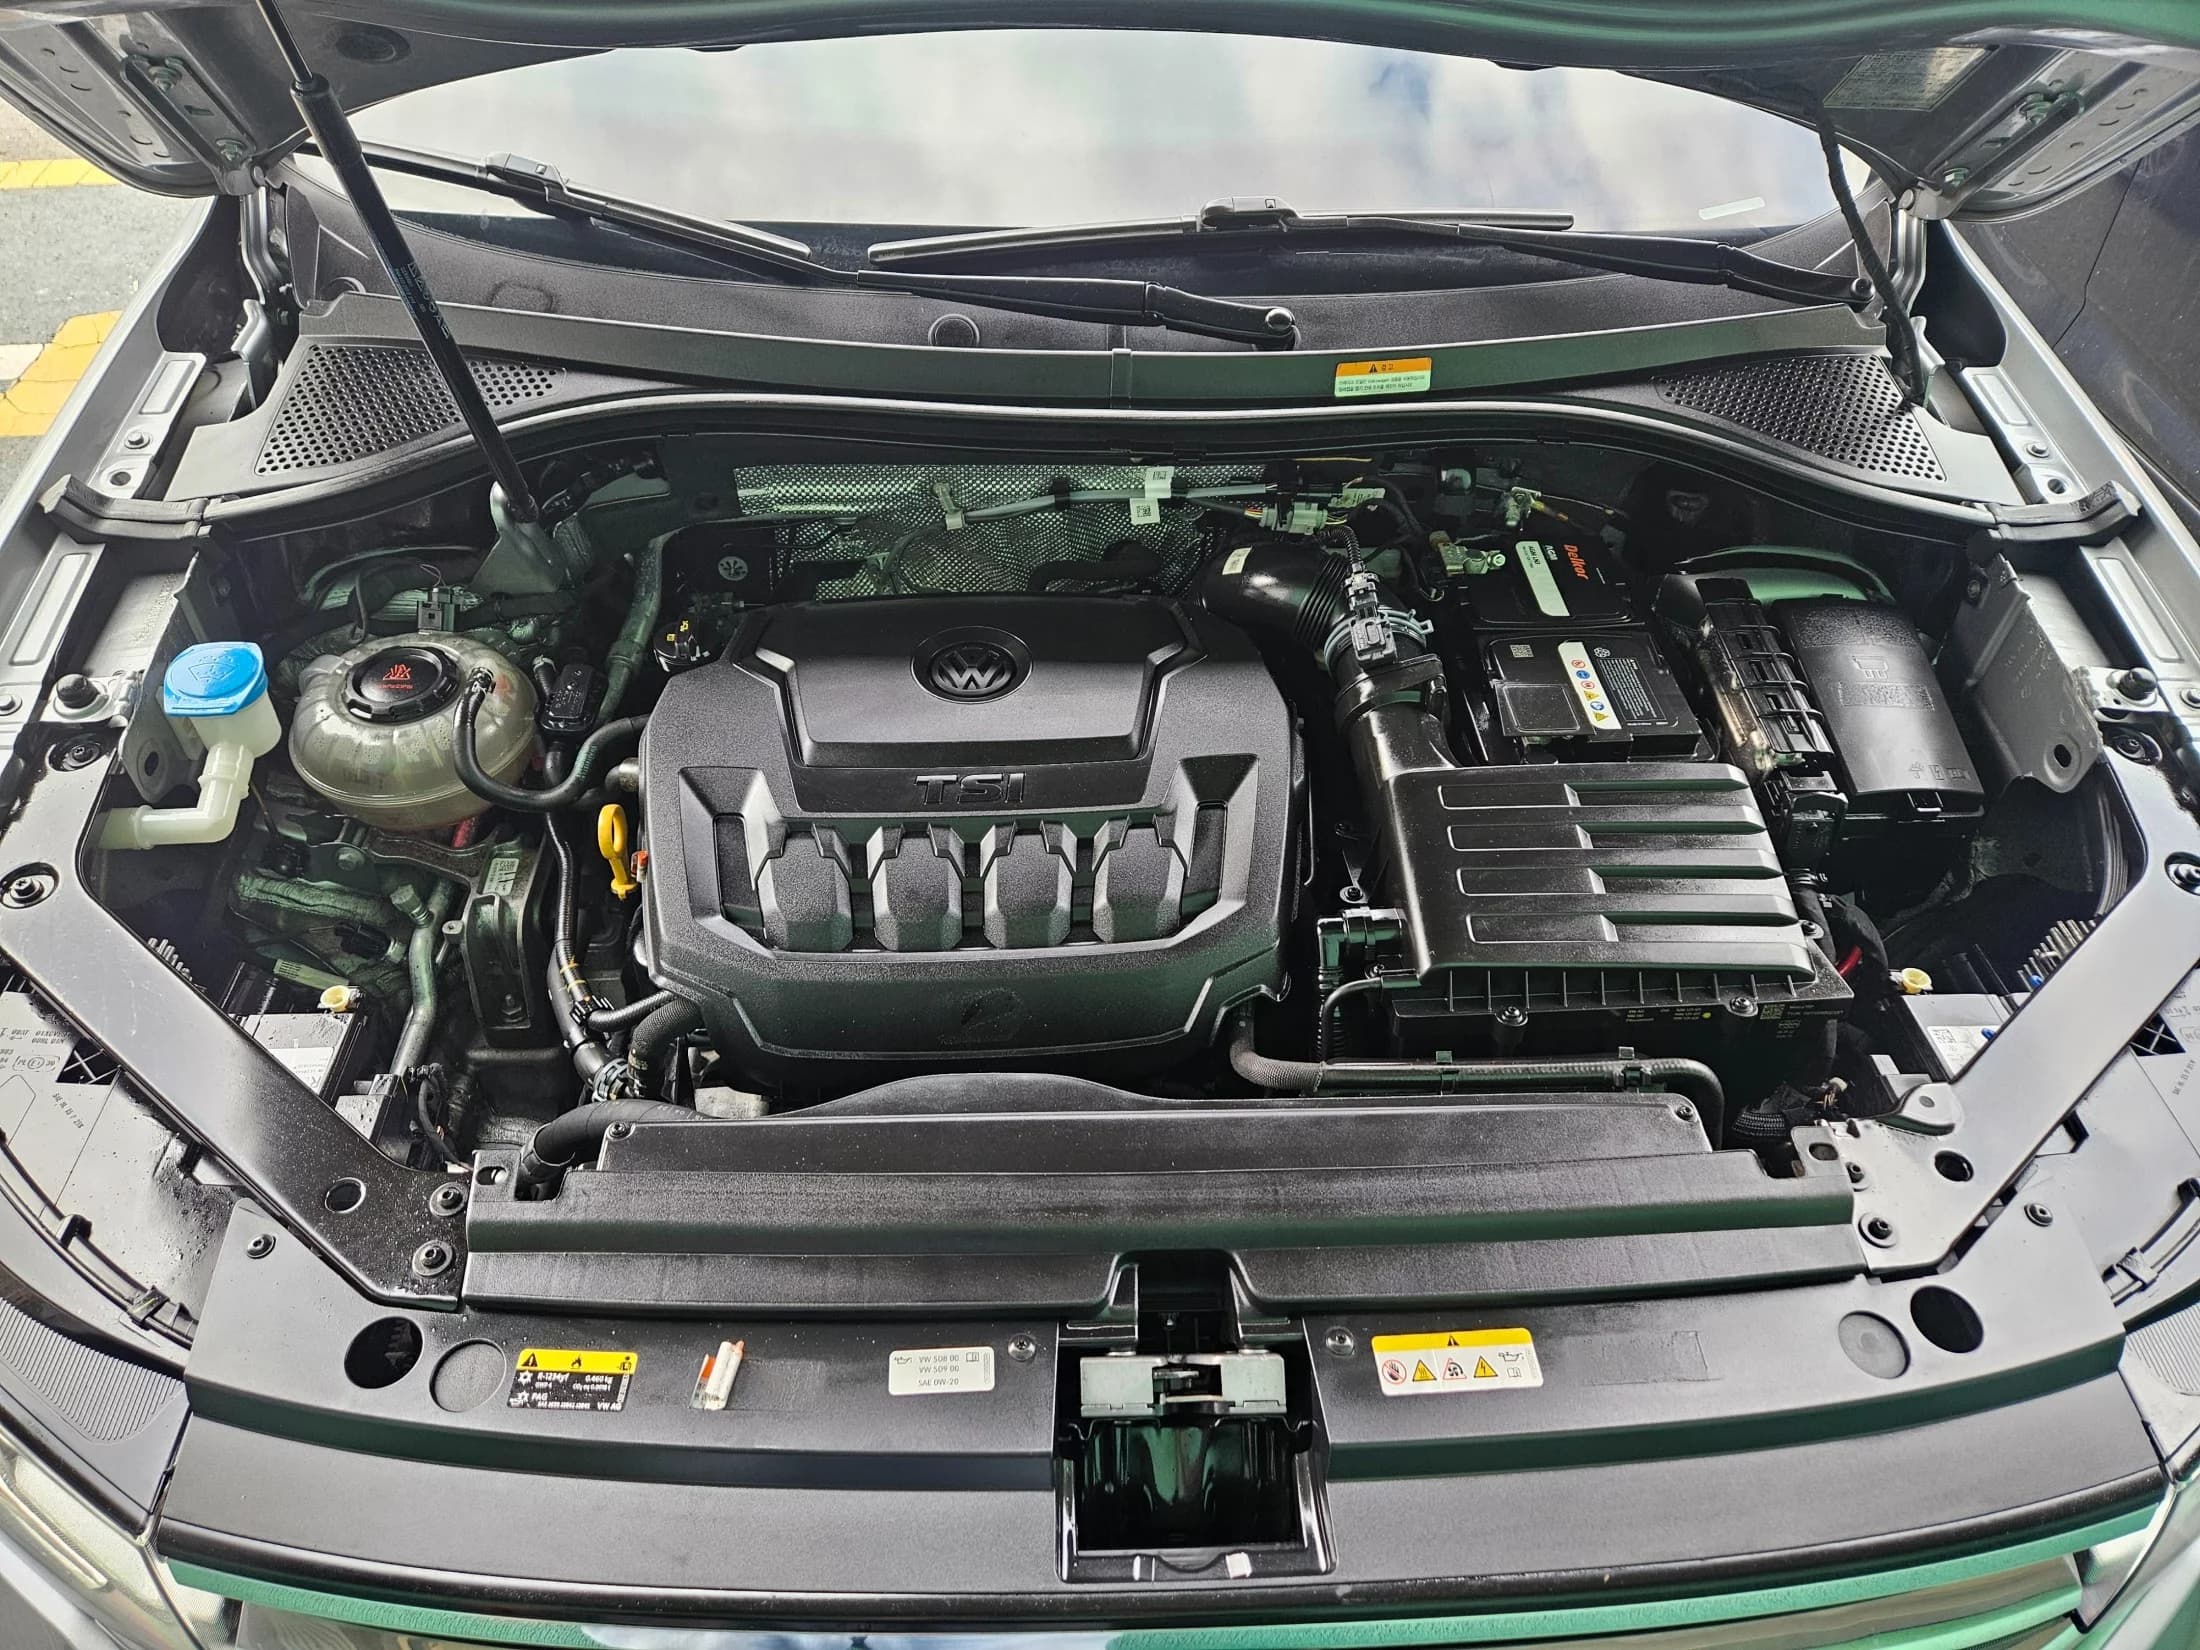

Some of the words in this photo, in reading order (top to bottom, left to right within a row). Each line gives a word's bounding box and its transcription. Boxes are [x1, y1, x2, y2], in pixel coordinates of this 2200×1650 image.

[1563, 543, 1589, 580] Delkor
[915, 772, 1026, 805] TSI
[918, 1355, 932, 1364] VW
[933, 1355, 948, 1363] 508
[949, 1354, 960, 1362] 00
[918, 1366, 932, 1374] VW
[933, 1365, 948, 1373] 509
[949, 1364, 960, 1372] 00
[933, 1377, 959, 1386] 0W-20
[531, 1392, 548, 1401] PAG
[597, 1401, 610, 1411] VW
[610, 1402, 622, 1411] AG
